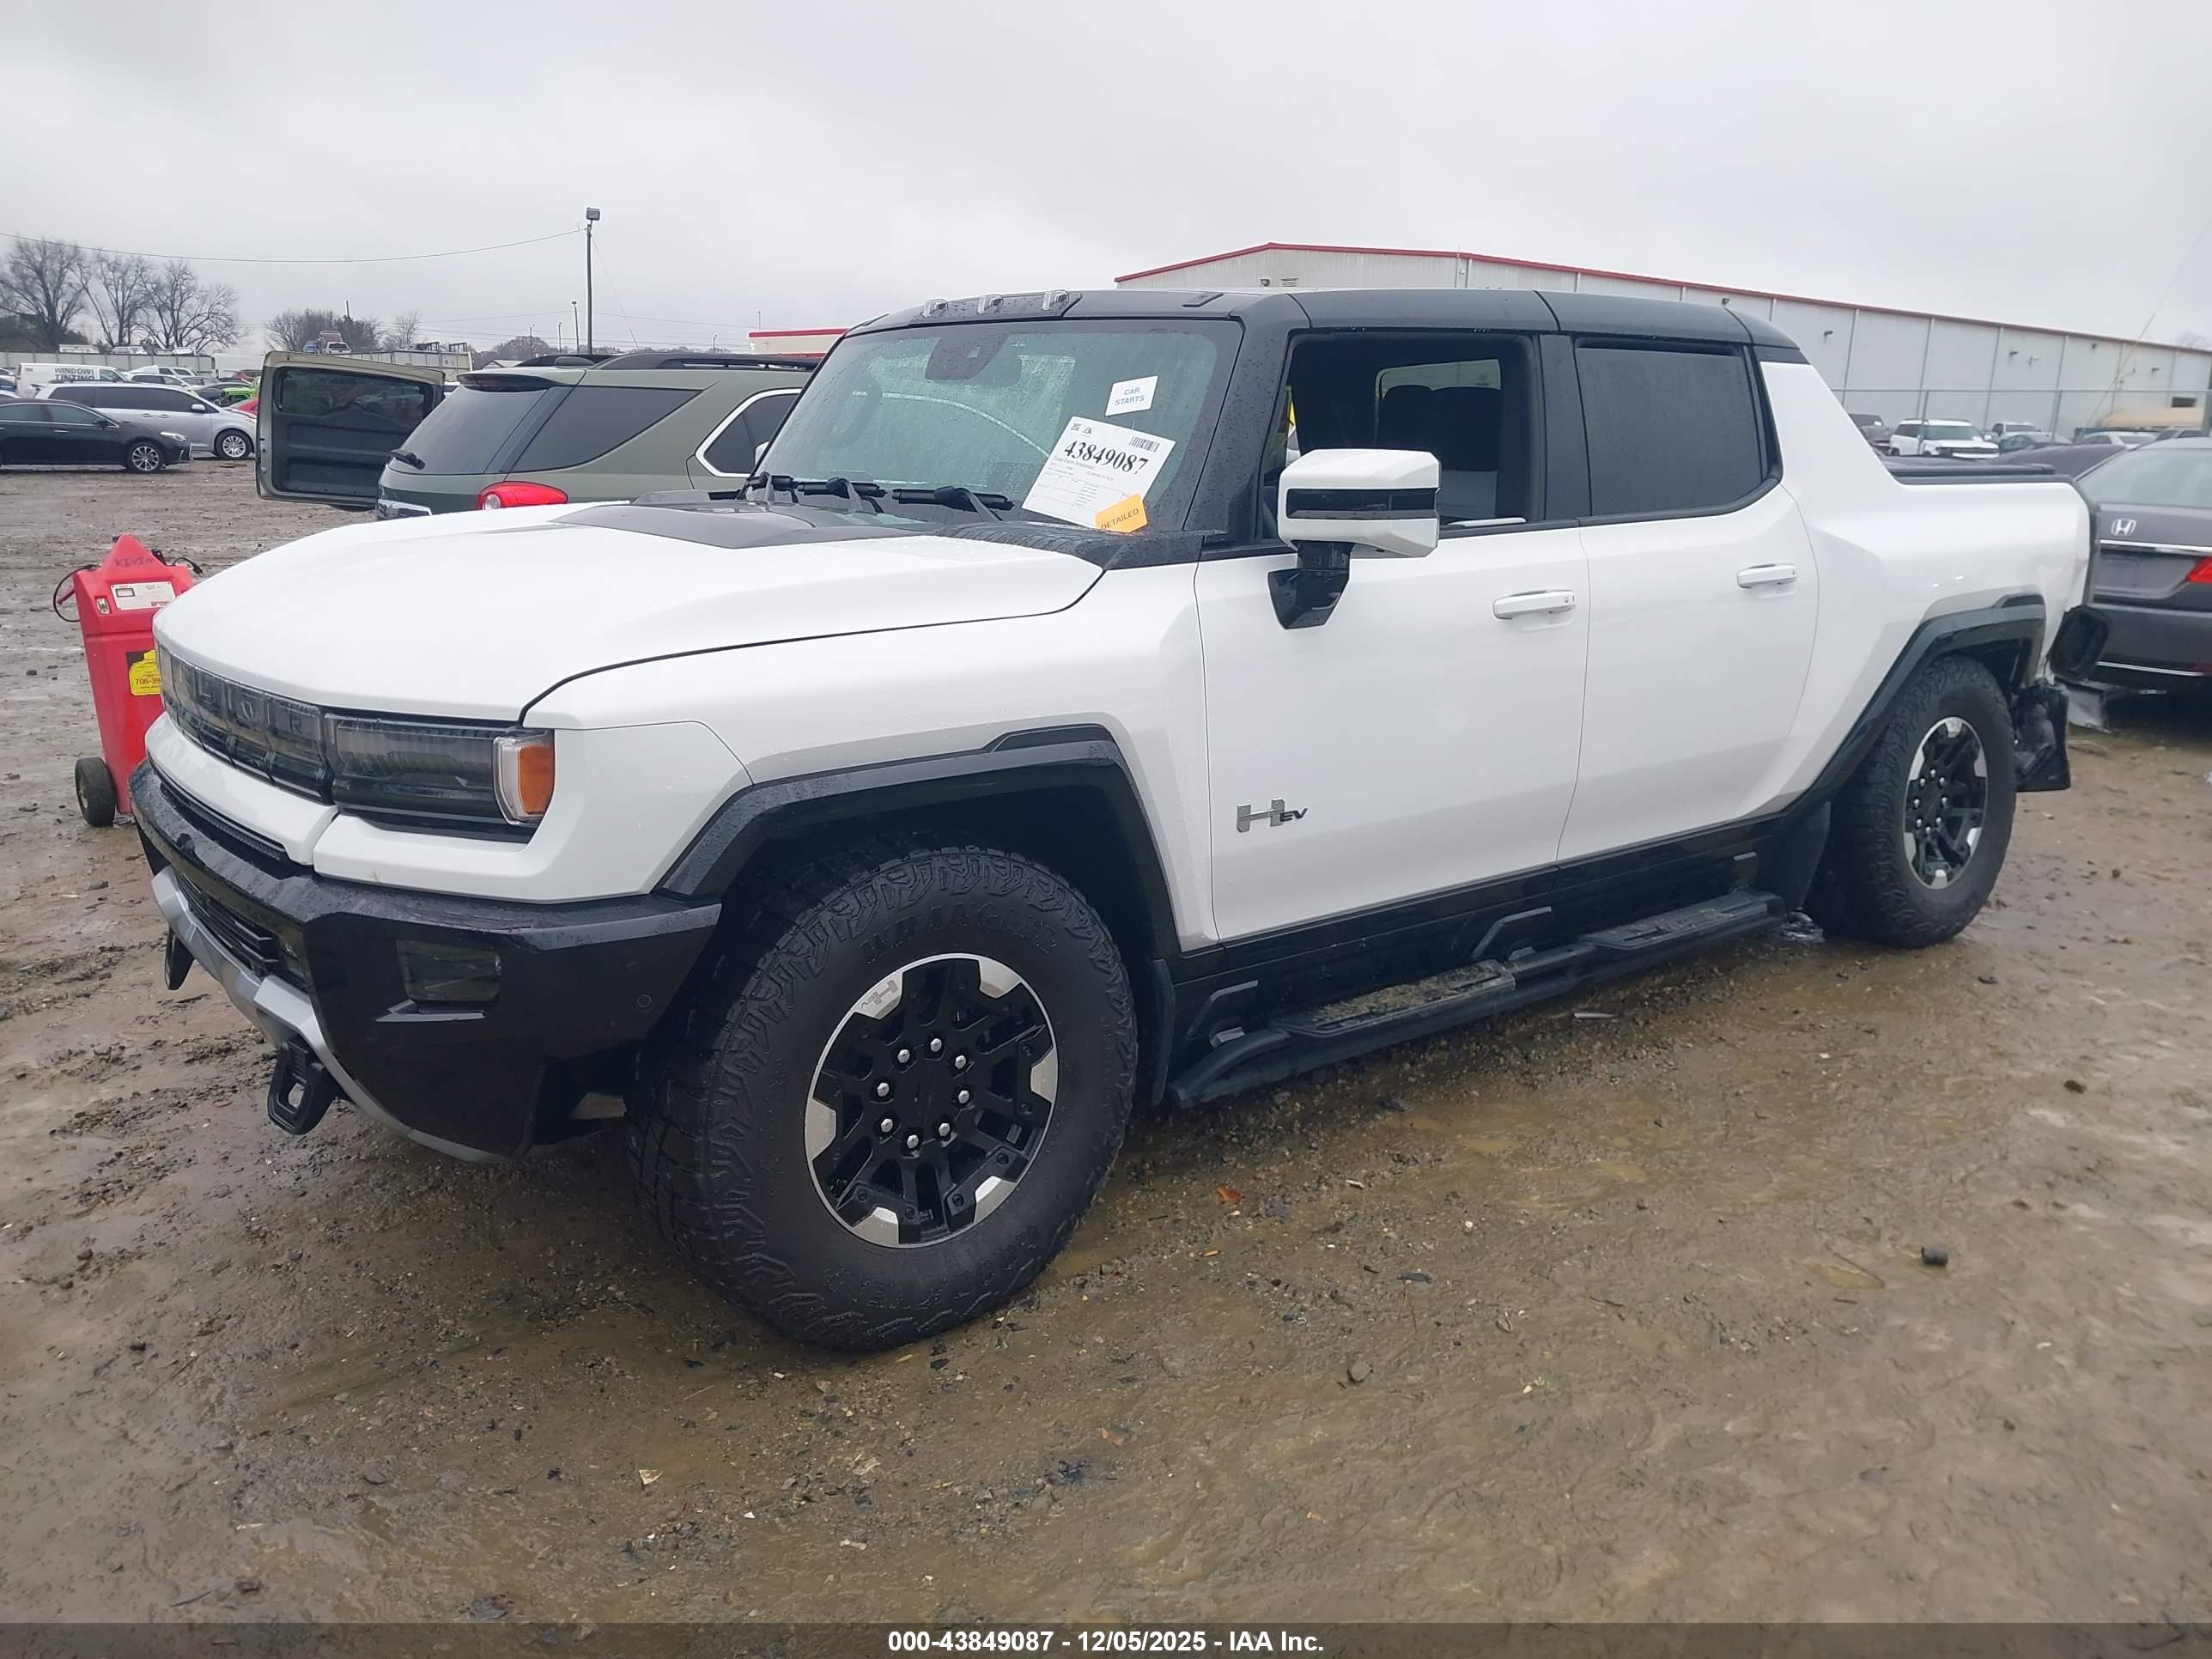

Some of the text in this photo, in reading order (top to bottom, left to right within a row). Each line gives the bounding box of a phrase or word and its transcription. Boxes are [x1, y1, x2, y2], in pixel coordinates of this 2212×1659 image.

[1124, 386, 1140, 396] CAR
[1115, 394, 1146, 406] STARTS
[1064, 441, 1150, 475] 43849087
[1101, 508, 1139, 531] DETAILED
[115, 556, 153, 567] KEVIN
